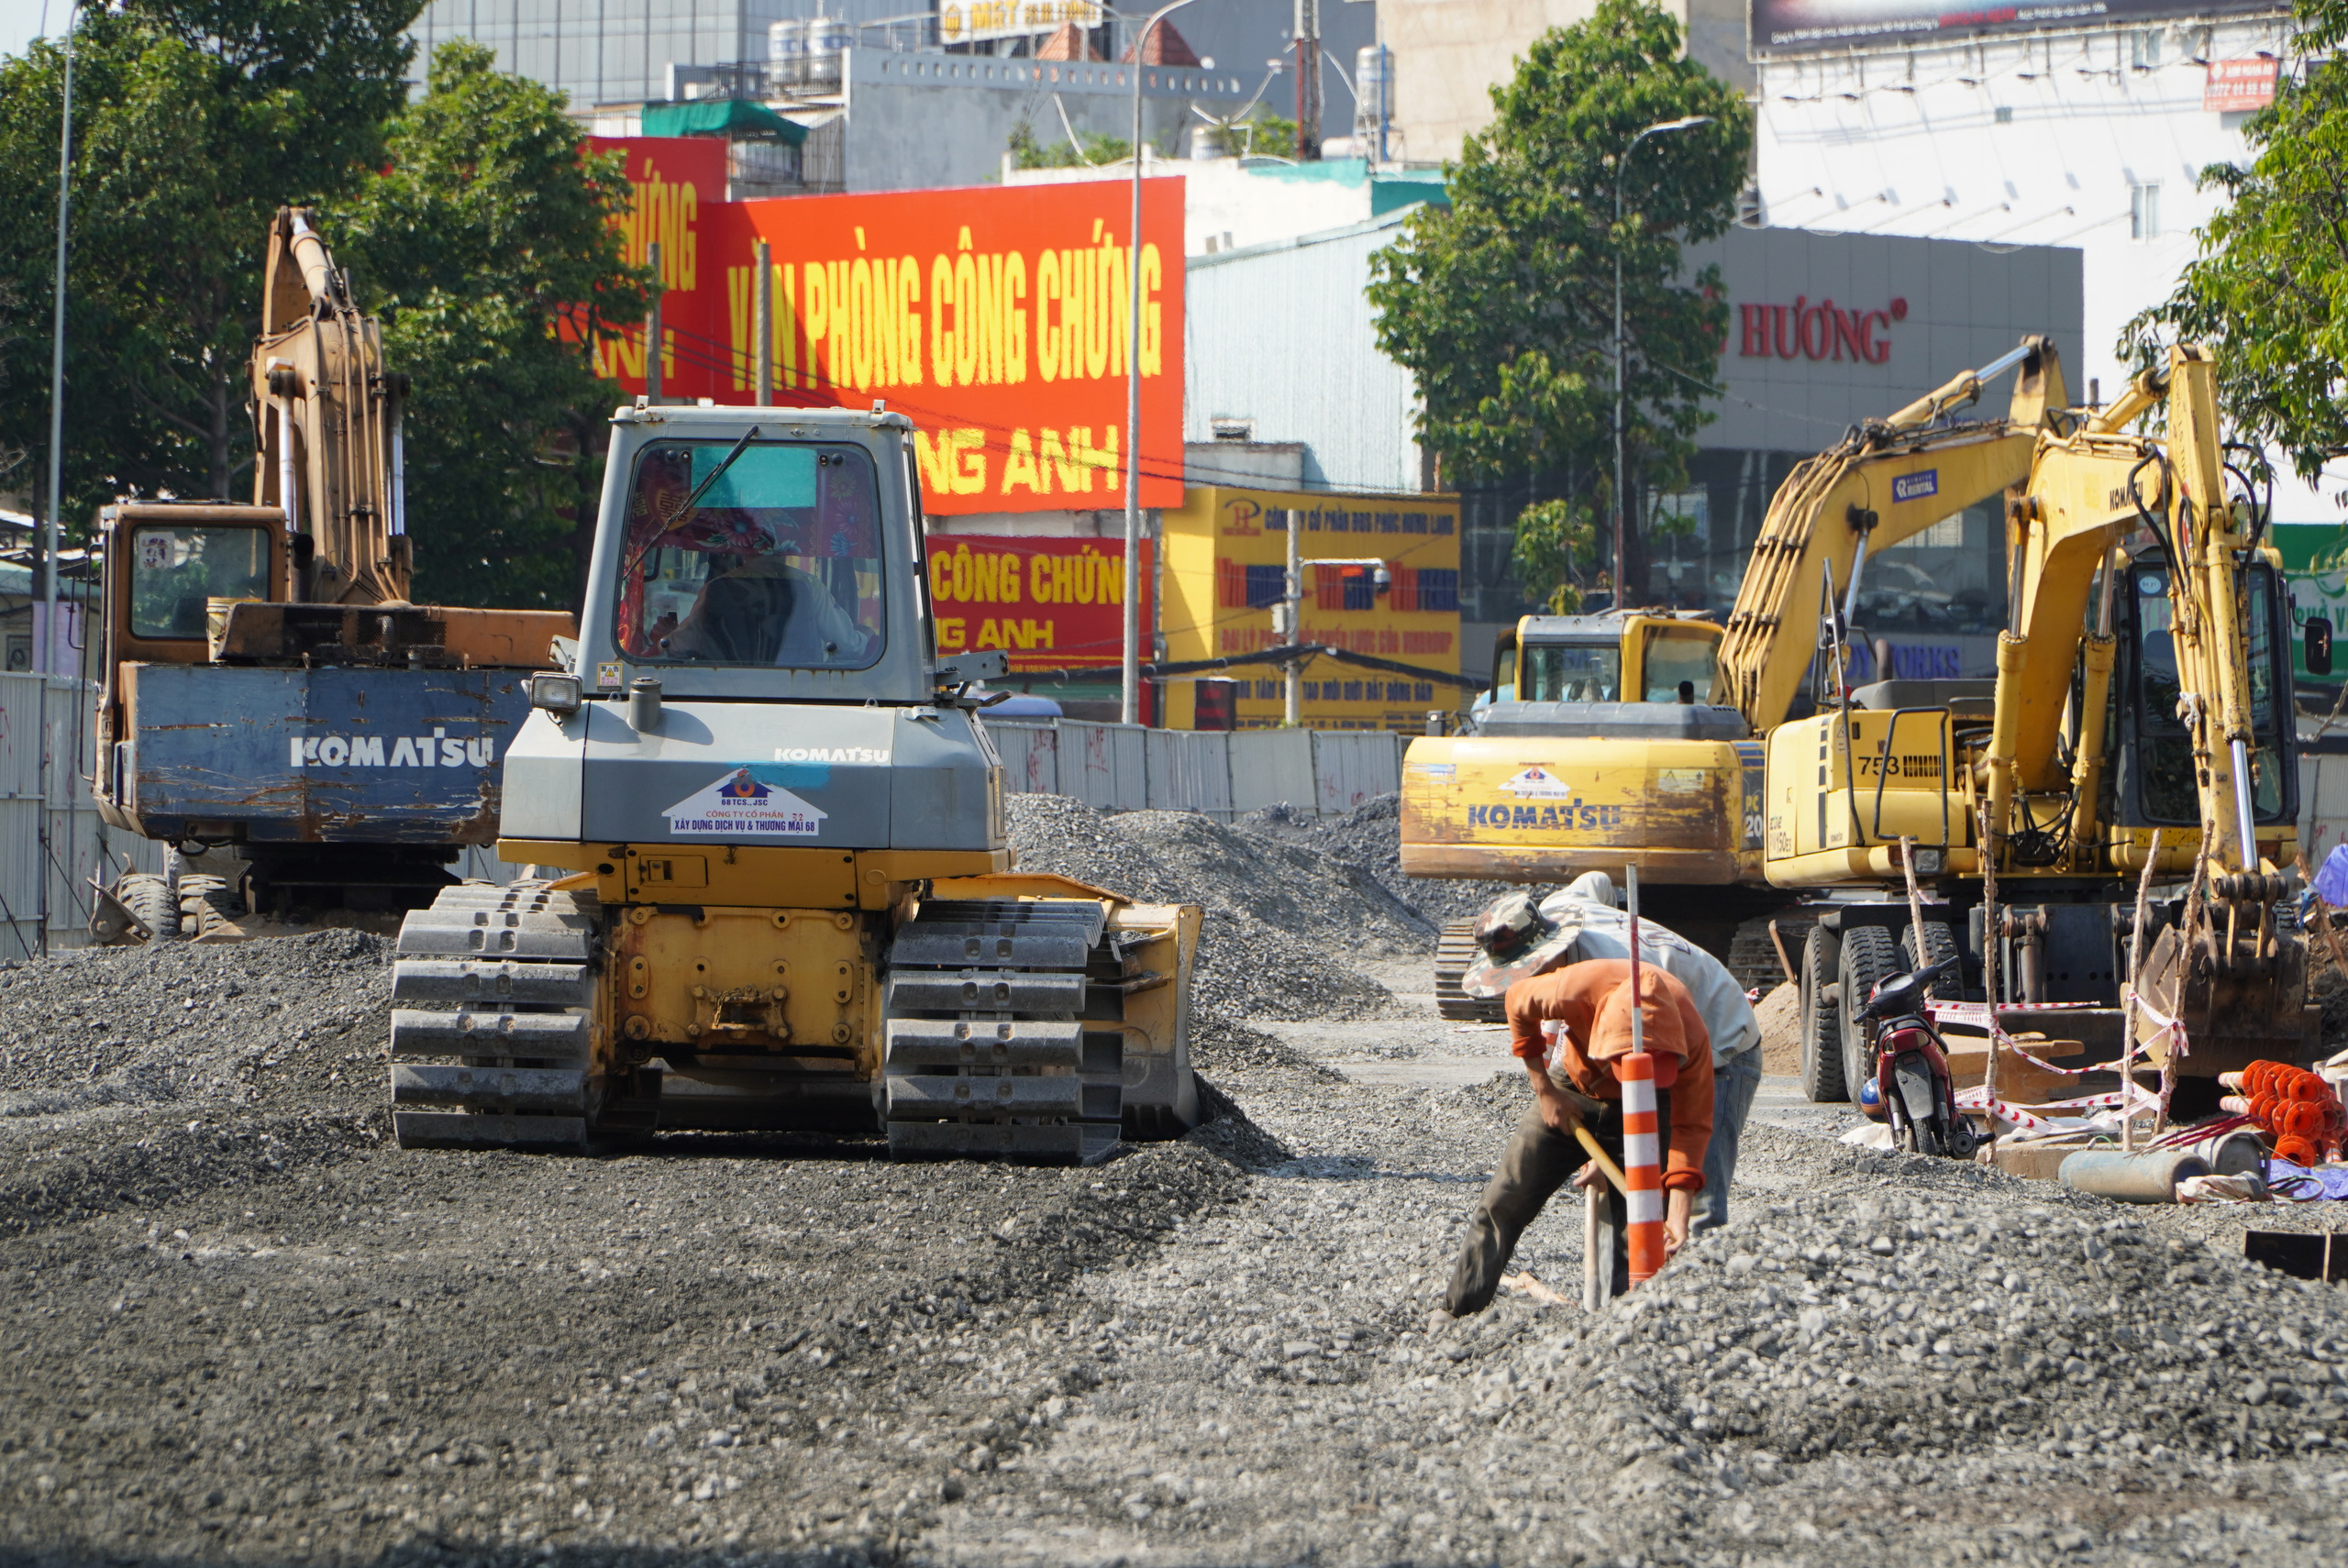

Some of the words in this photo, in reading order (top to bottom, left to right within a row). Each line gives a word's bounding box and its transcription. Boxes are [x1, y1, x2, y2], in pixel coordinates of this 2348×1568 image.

[601, 158, 697, 292] HỨNG
[804, 226, 922, 393] PHÒNG
[931, 226, 1026, 386] CÔNG
[1036, 219, 1162, 382] CHỨNG
[1739, 295, 1892, 365] HƯƠNG
[1001, 425, 1119, 495] ANH
[1908, 481, 1934, 496] RENTAL
[1264, 505, 1289, 531] CÔN
[930, 543, 1021, 602] CÔNG
[976, 618, 1054, 649] ANH
[1890, 645, 1960, 679] ORKS
[290, 727, 494, 768] KOMATSU
[774, 746, 890, 763] KOMATSU
[1858, 756, 1899, 775] 753
[705, 809, 730, 818] CÔNG
[1468, 798, 1621, 831] KOMATSU
[1745, 794, 1759, 812] PC
[674, 818, 690, 830] XÂY
[692, 820, 714, 833] DỰNG
[715, 820, 733, 833] DỊCH
[736, 821, 745, 833] VỤ
[748, 821, 753, 831] &
[755, 820, 786, 831] THƯƠNG
[788, 821, 803, 834] MẠI
[805, 822, 815, 832] 68
